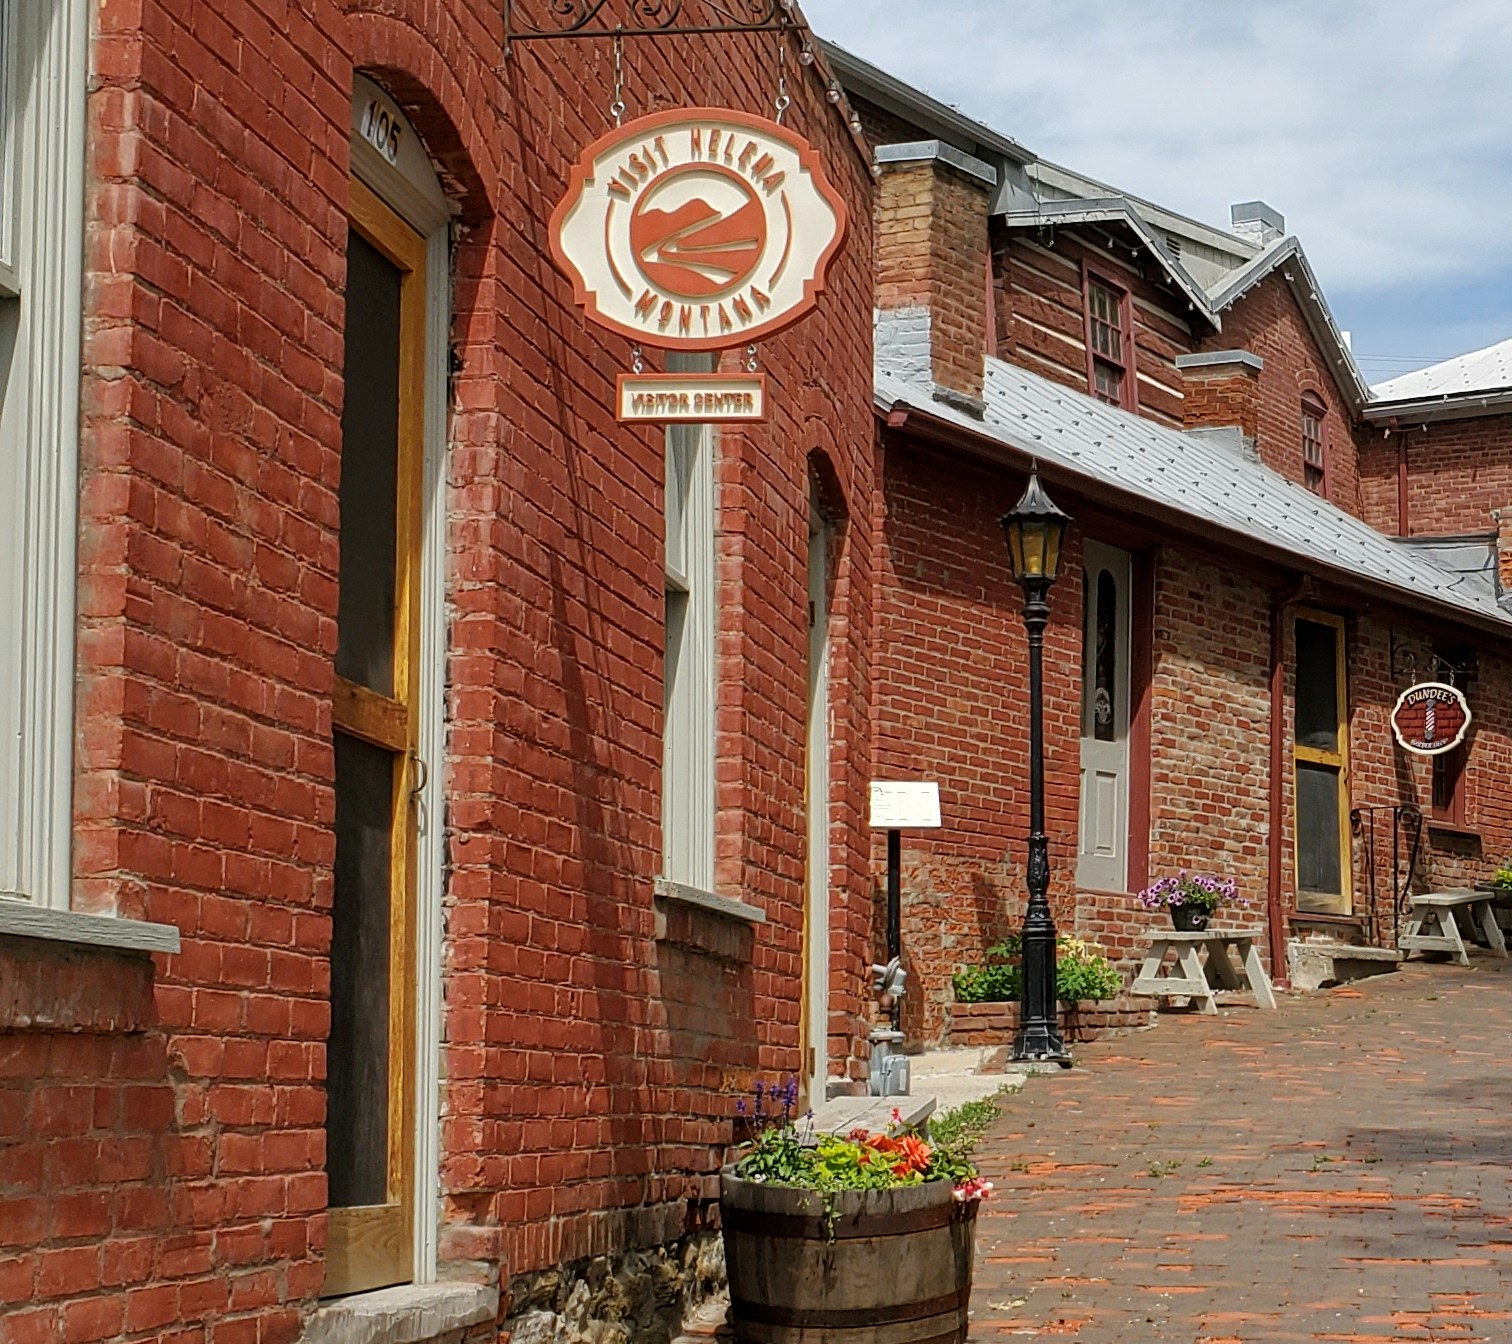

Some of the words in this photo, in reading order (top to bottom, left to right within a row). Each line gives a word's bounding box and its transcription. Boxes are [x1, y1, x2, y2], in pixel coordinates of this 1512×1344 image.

[361, 100, 401, 163] 105
[607, 136, 670, 196] VISIT
[690, 128, 785, 192] HELENA
[635, 285, 771, 335] MONTANA
[631, 392, 690, 409] VISITOR
[693, 392, 754, 409] CENTER
[1407, 688, 1456, 705] DUNDEE'S
